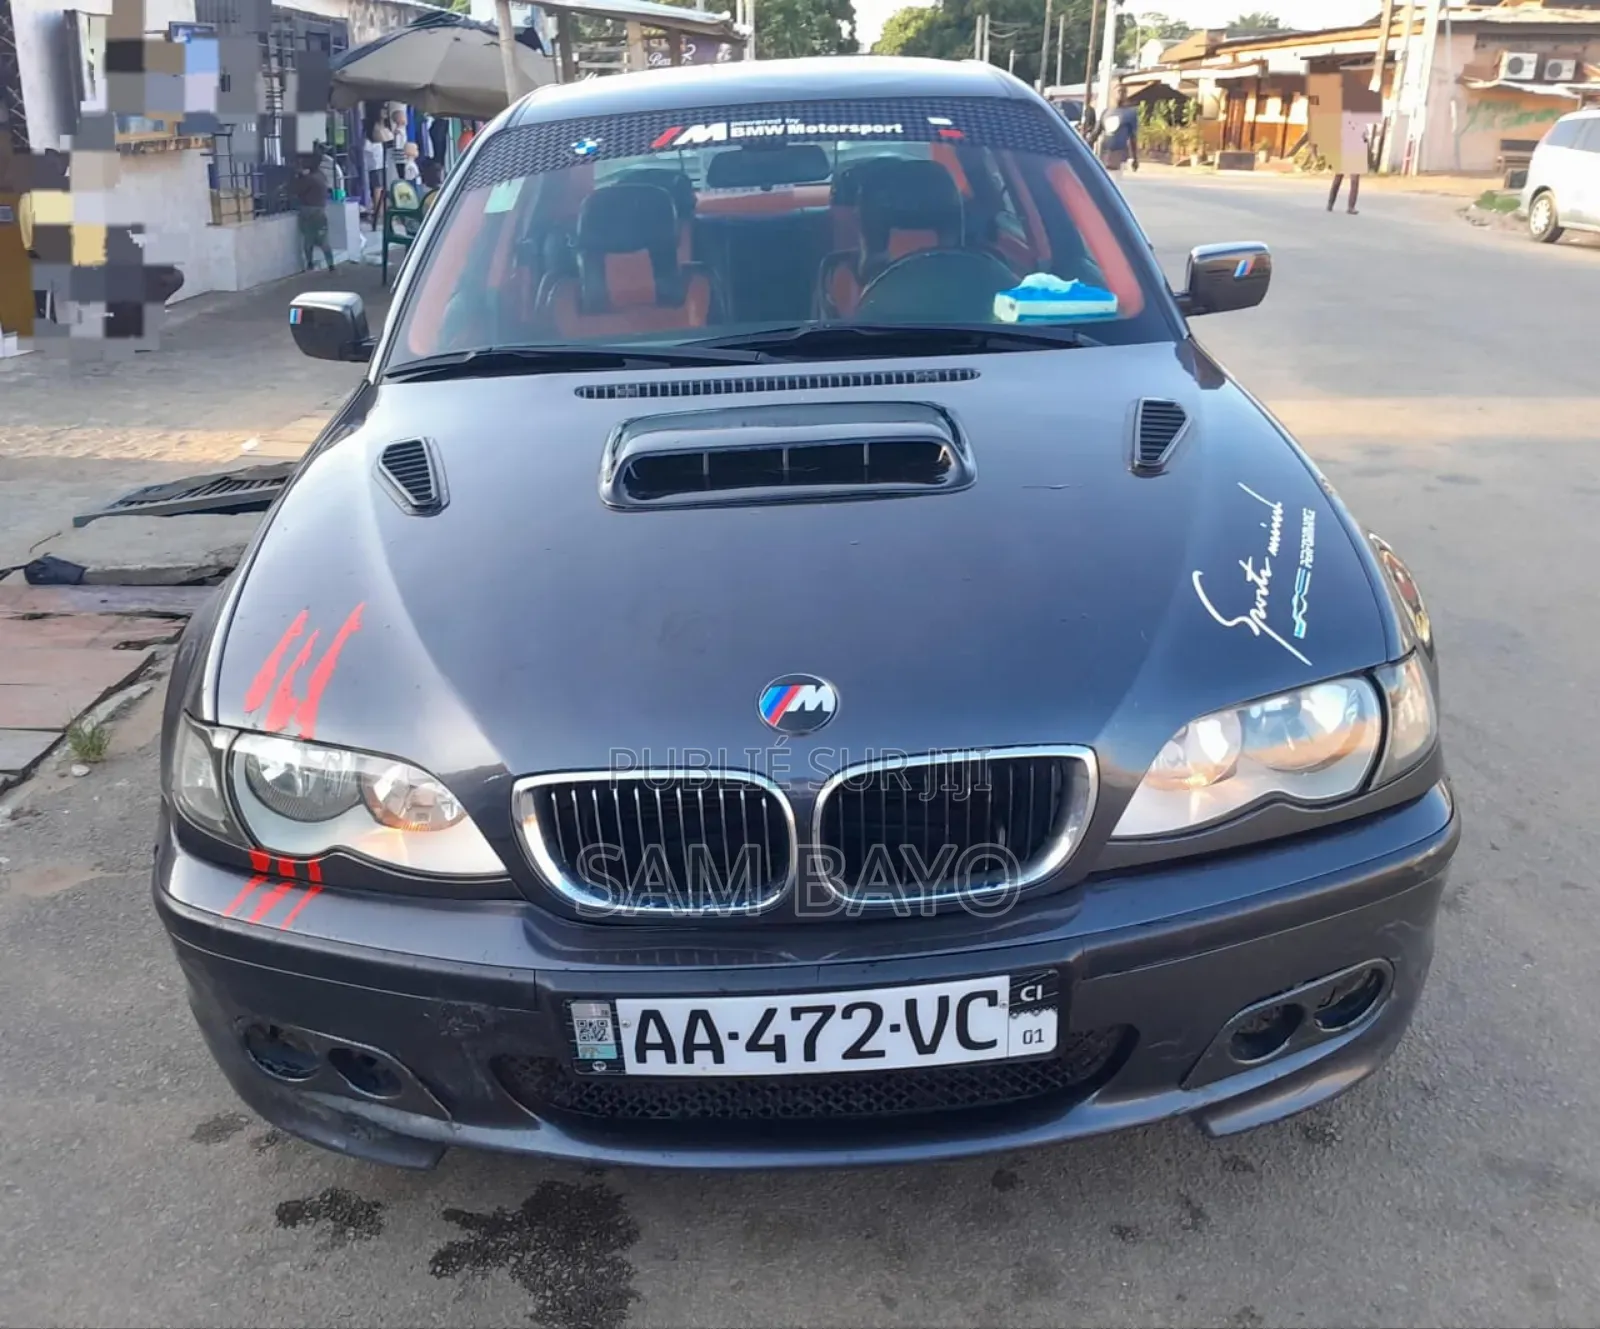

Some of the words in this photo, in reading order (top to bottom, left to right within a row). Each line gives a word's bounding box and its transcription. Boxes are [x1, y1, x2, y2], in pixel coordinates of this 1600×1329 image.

[730, 118, 782, 128] powered
[785, 117, 801, 125] by
[730, 124, 785, 138] BMW
[787, 122, 904, 135] Motorsport
[1020, 984, 1043, 1002] CI
[1022, 1028, 1045, 1045] 01
